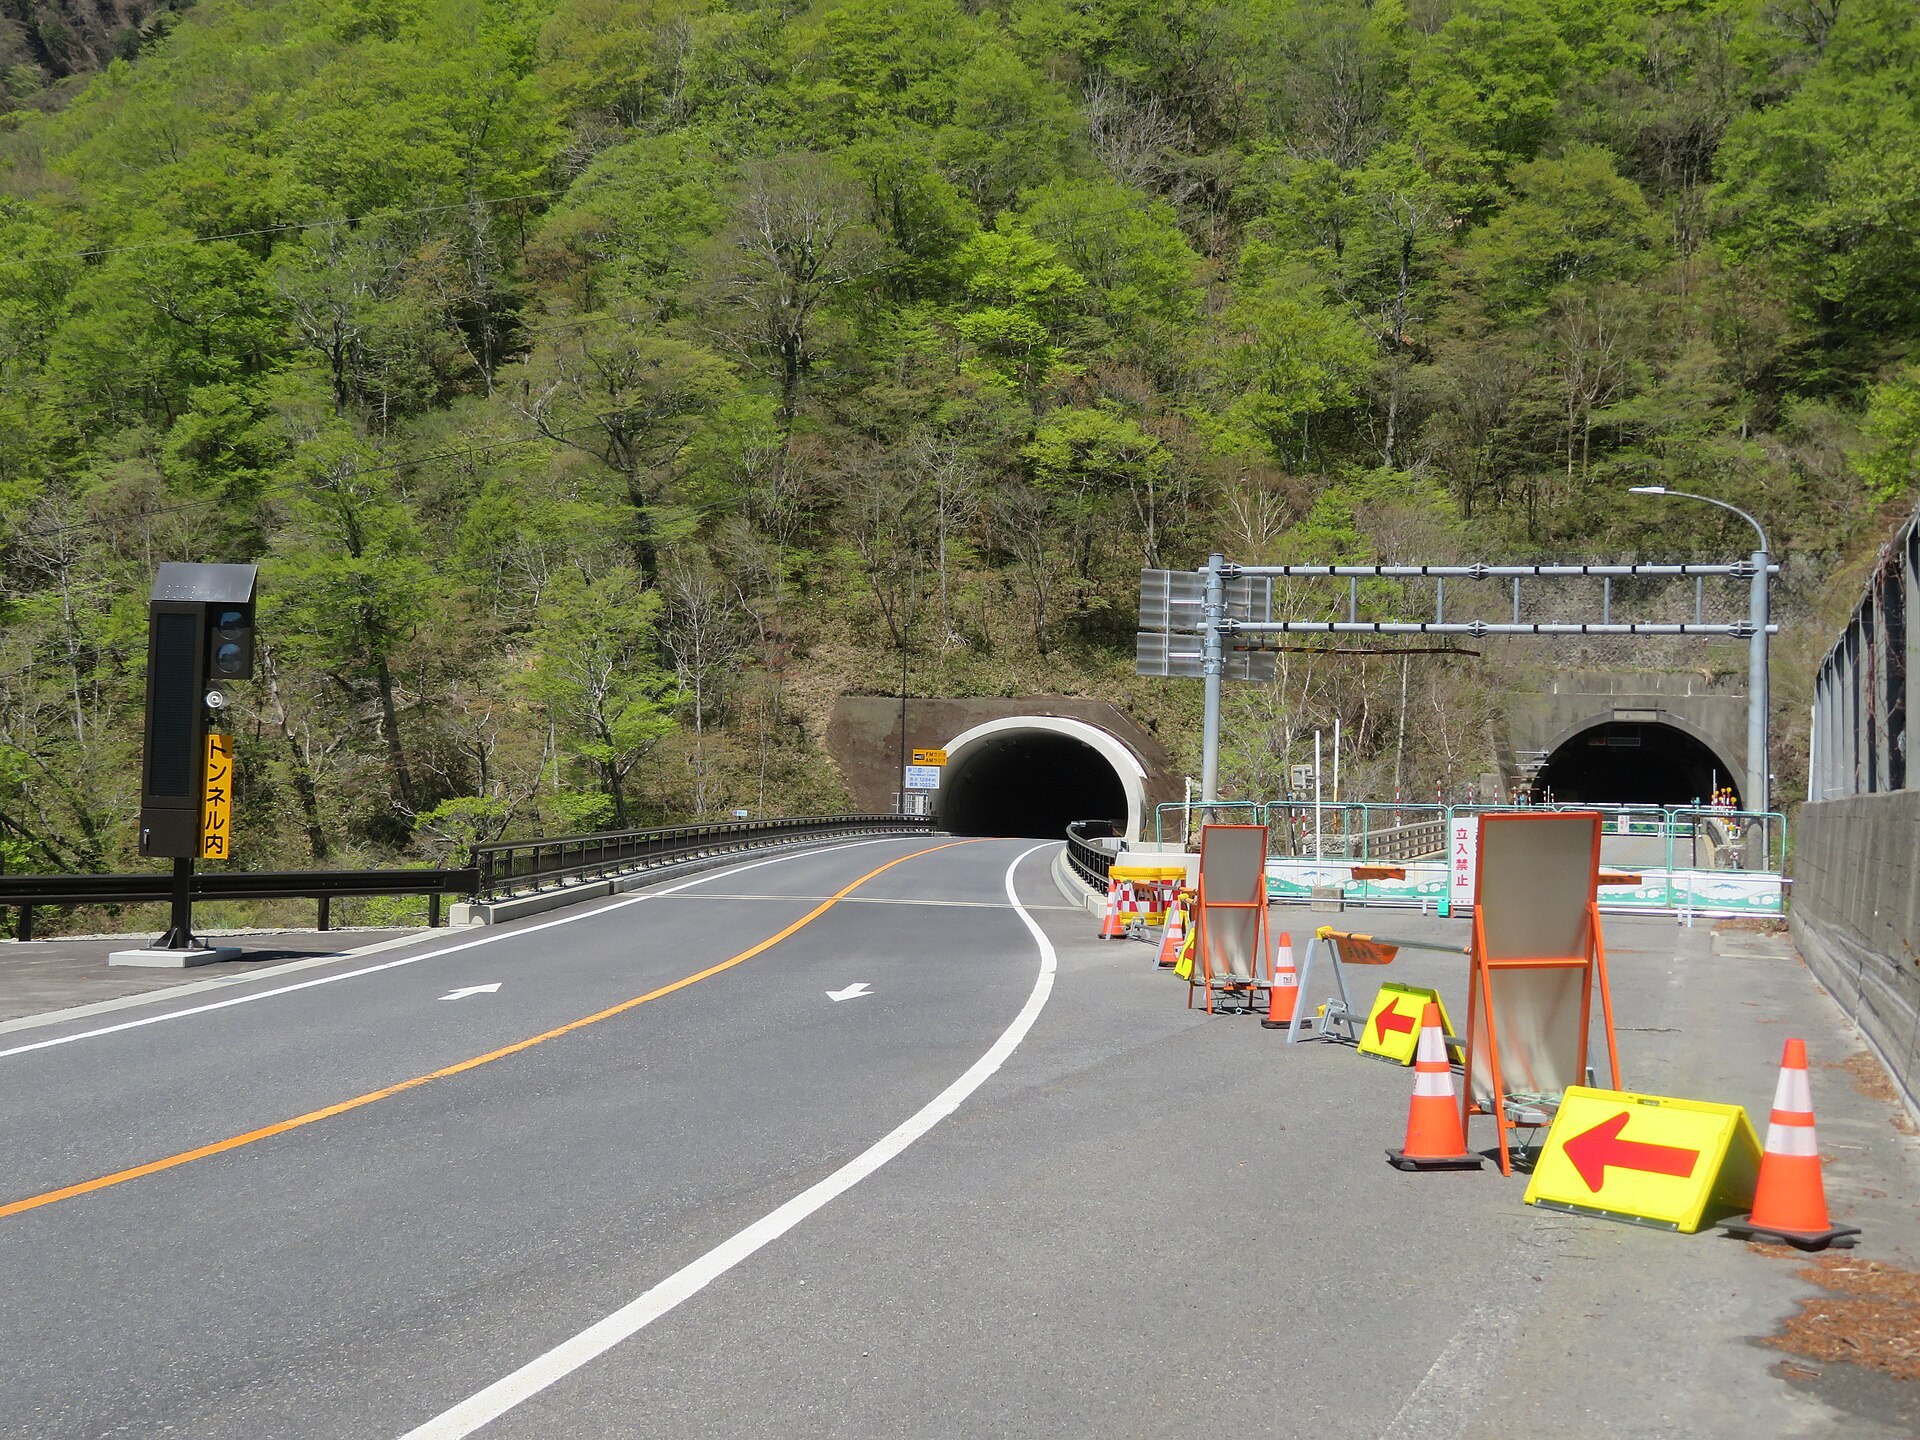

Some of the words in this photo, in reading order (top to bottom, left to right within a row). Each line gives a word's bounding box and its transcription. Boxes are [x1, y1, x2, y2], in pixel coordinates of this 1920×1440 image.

[205, 739, 227, 855] トンネル内
[1456, 828, 1469, 887] 立入禁止
